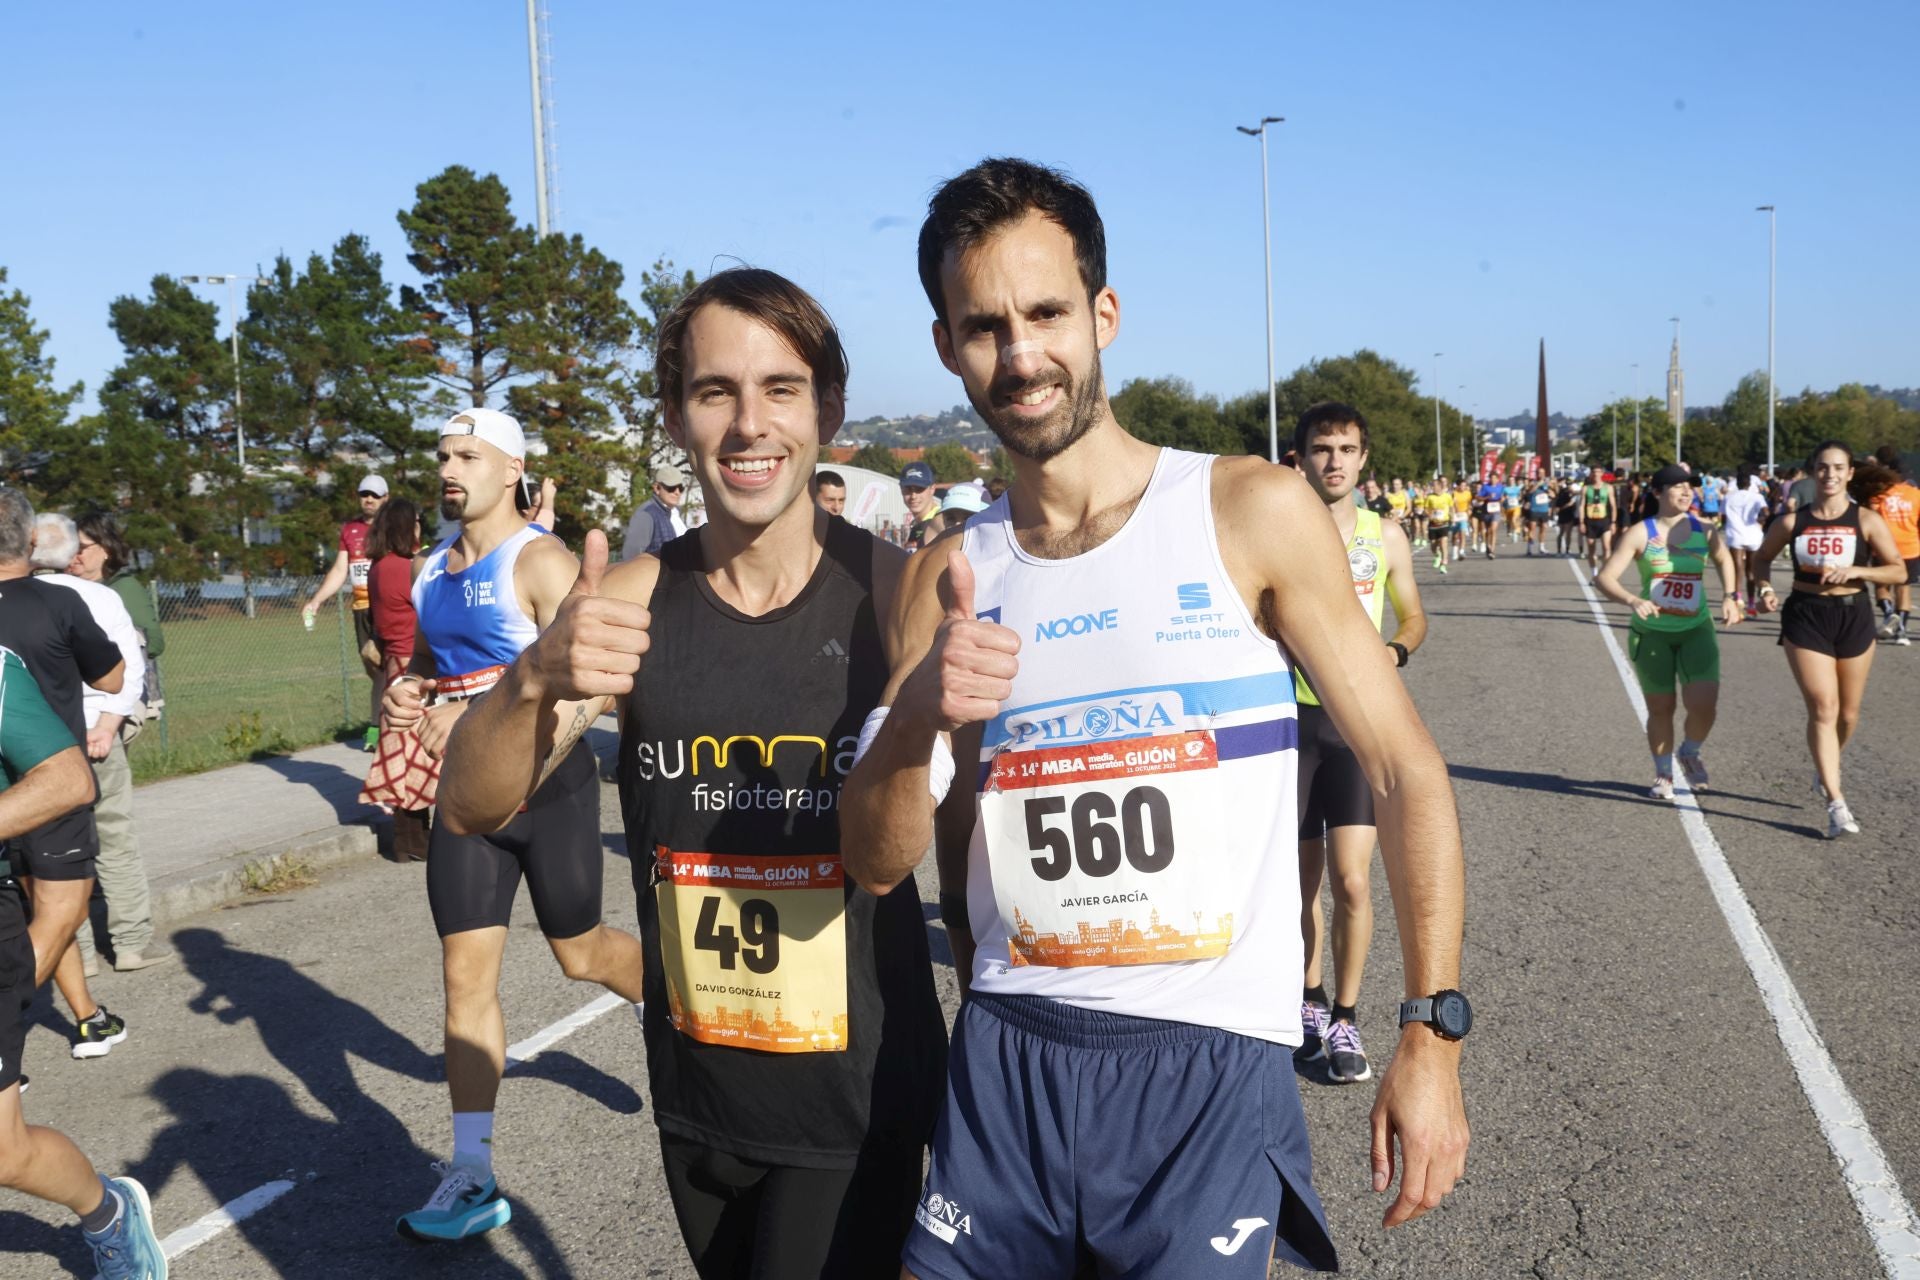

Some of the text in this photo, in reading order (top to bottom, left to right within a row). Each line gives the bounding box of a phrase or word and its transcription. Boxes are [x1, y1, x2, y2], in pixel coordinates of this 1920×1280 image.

[1807, 537, 1843, 555] 656
[479, 581, 493, 589] YES
[1662, 580, 1693, 599] 789
[479, 597, 496, 606] RUN
[1035, 608, 1118, 642] NOONE
[1170, 613, 1224, 625] SEAT
[1156, 626, 1240, 643] Puerta Otero
[1042, 758, 1087, 775] MBA
[1088, 753, 1114, 763] media
[1125, 747, 1177, 767] GIJÓN
[1089, 761, 1124, 771] maratón
[1135, 765, 1162, 773] OCTUBRE
[692, 782, 841, 817] fisioterapi
[1024, 785, 1175, 881] 560
[693, 865, 732, 878] MBA
[734, 866, 755, 874] media
[764, 865, 810, 881] GIJÓN
[734, 873, 764, 881] maratón
[1061, 890, 1149, 908] JAVIER GARCÍA
[694, 896, 780, 974] 49
[695, 983, 781, 1000] DAVID GONZÁLEZ
